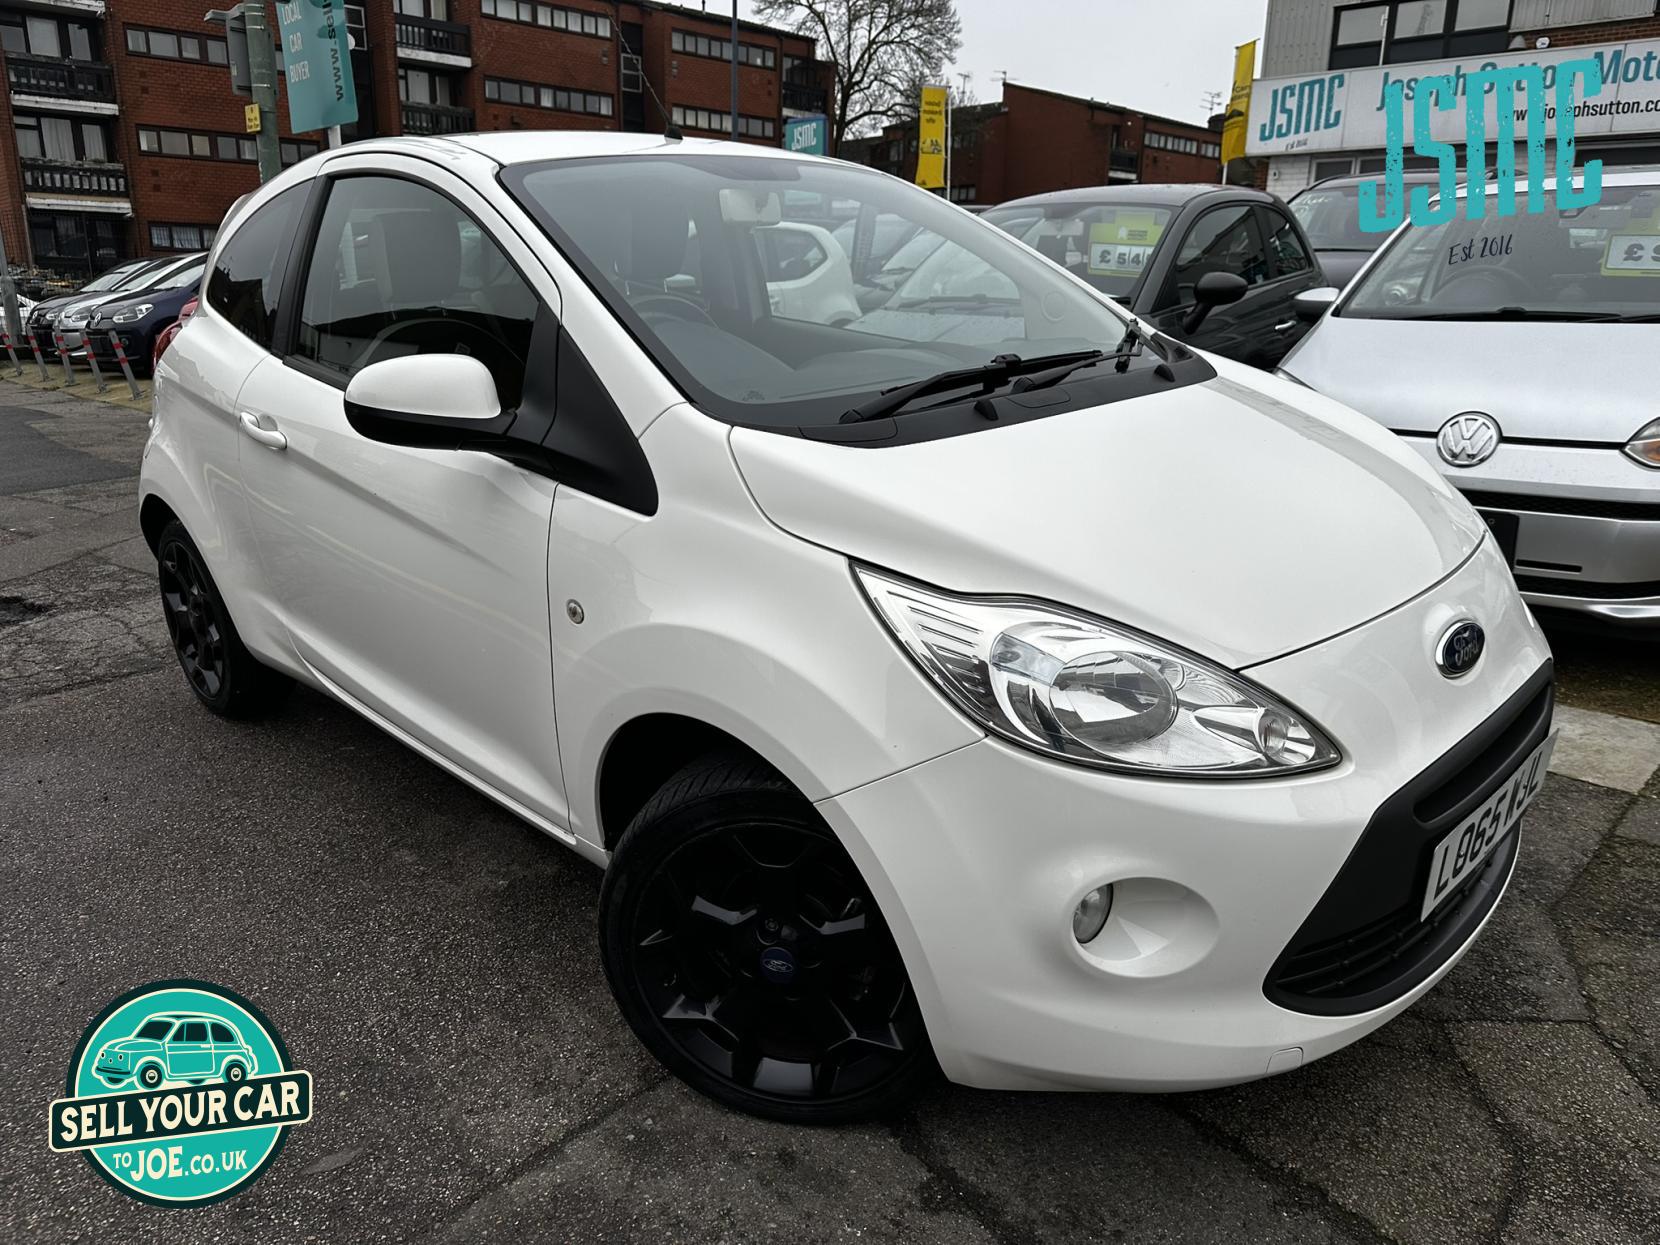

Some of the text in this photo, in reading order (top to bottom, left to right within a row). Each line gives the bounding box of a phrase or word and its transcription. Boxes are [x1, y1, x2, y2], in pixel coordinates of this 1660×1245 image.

[282, 0, 302, 25] LOCAL
[289, 32, 303, 53] CAR
[322, 0, 344, 101] www.sell
[289, 60, 310, 83] BUYER
[1594, 49, 1660, 84] Mot
[1259, 73, 1345, 142] JSMC
[791, 122, 817, 150] JSMC
[1099, 249, 1151, 267] £54
[1453, 630, 1479, 666] Ford
